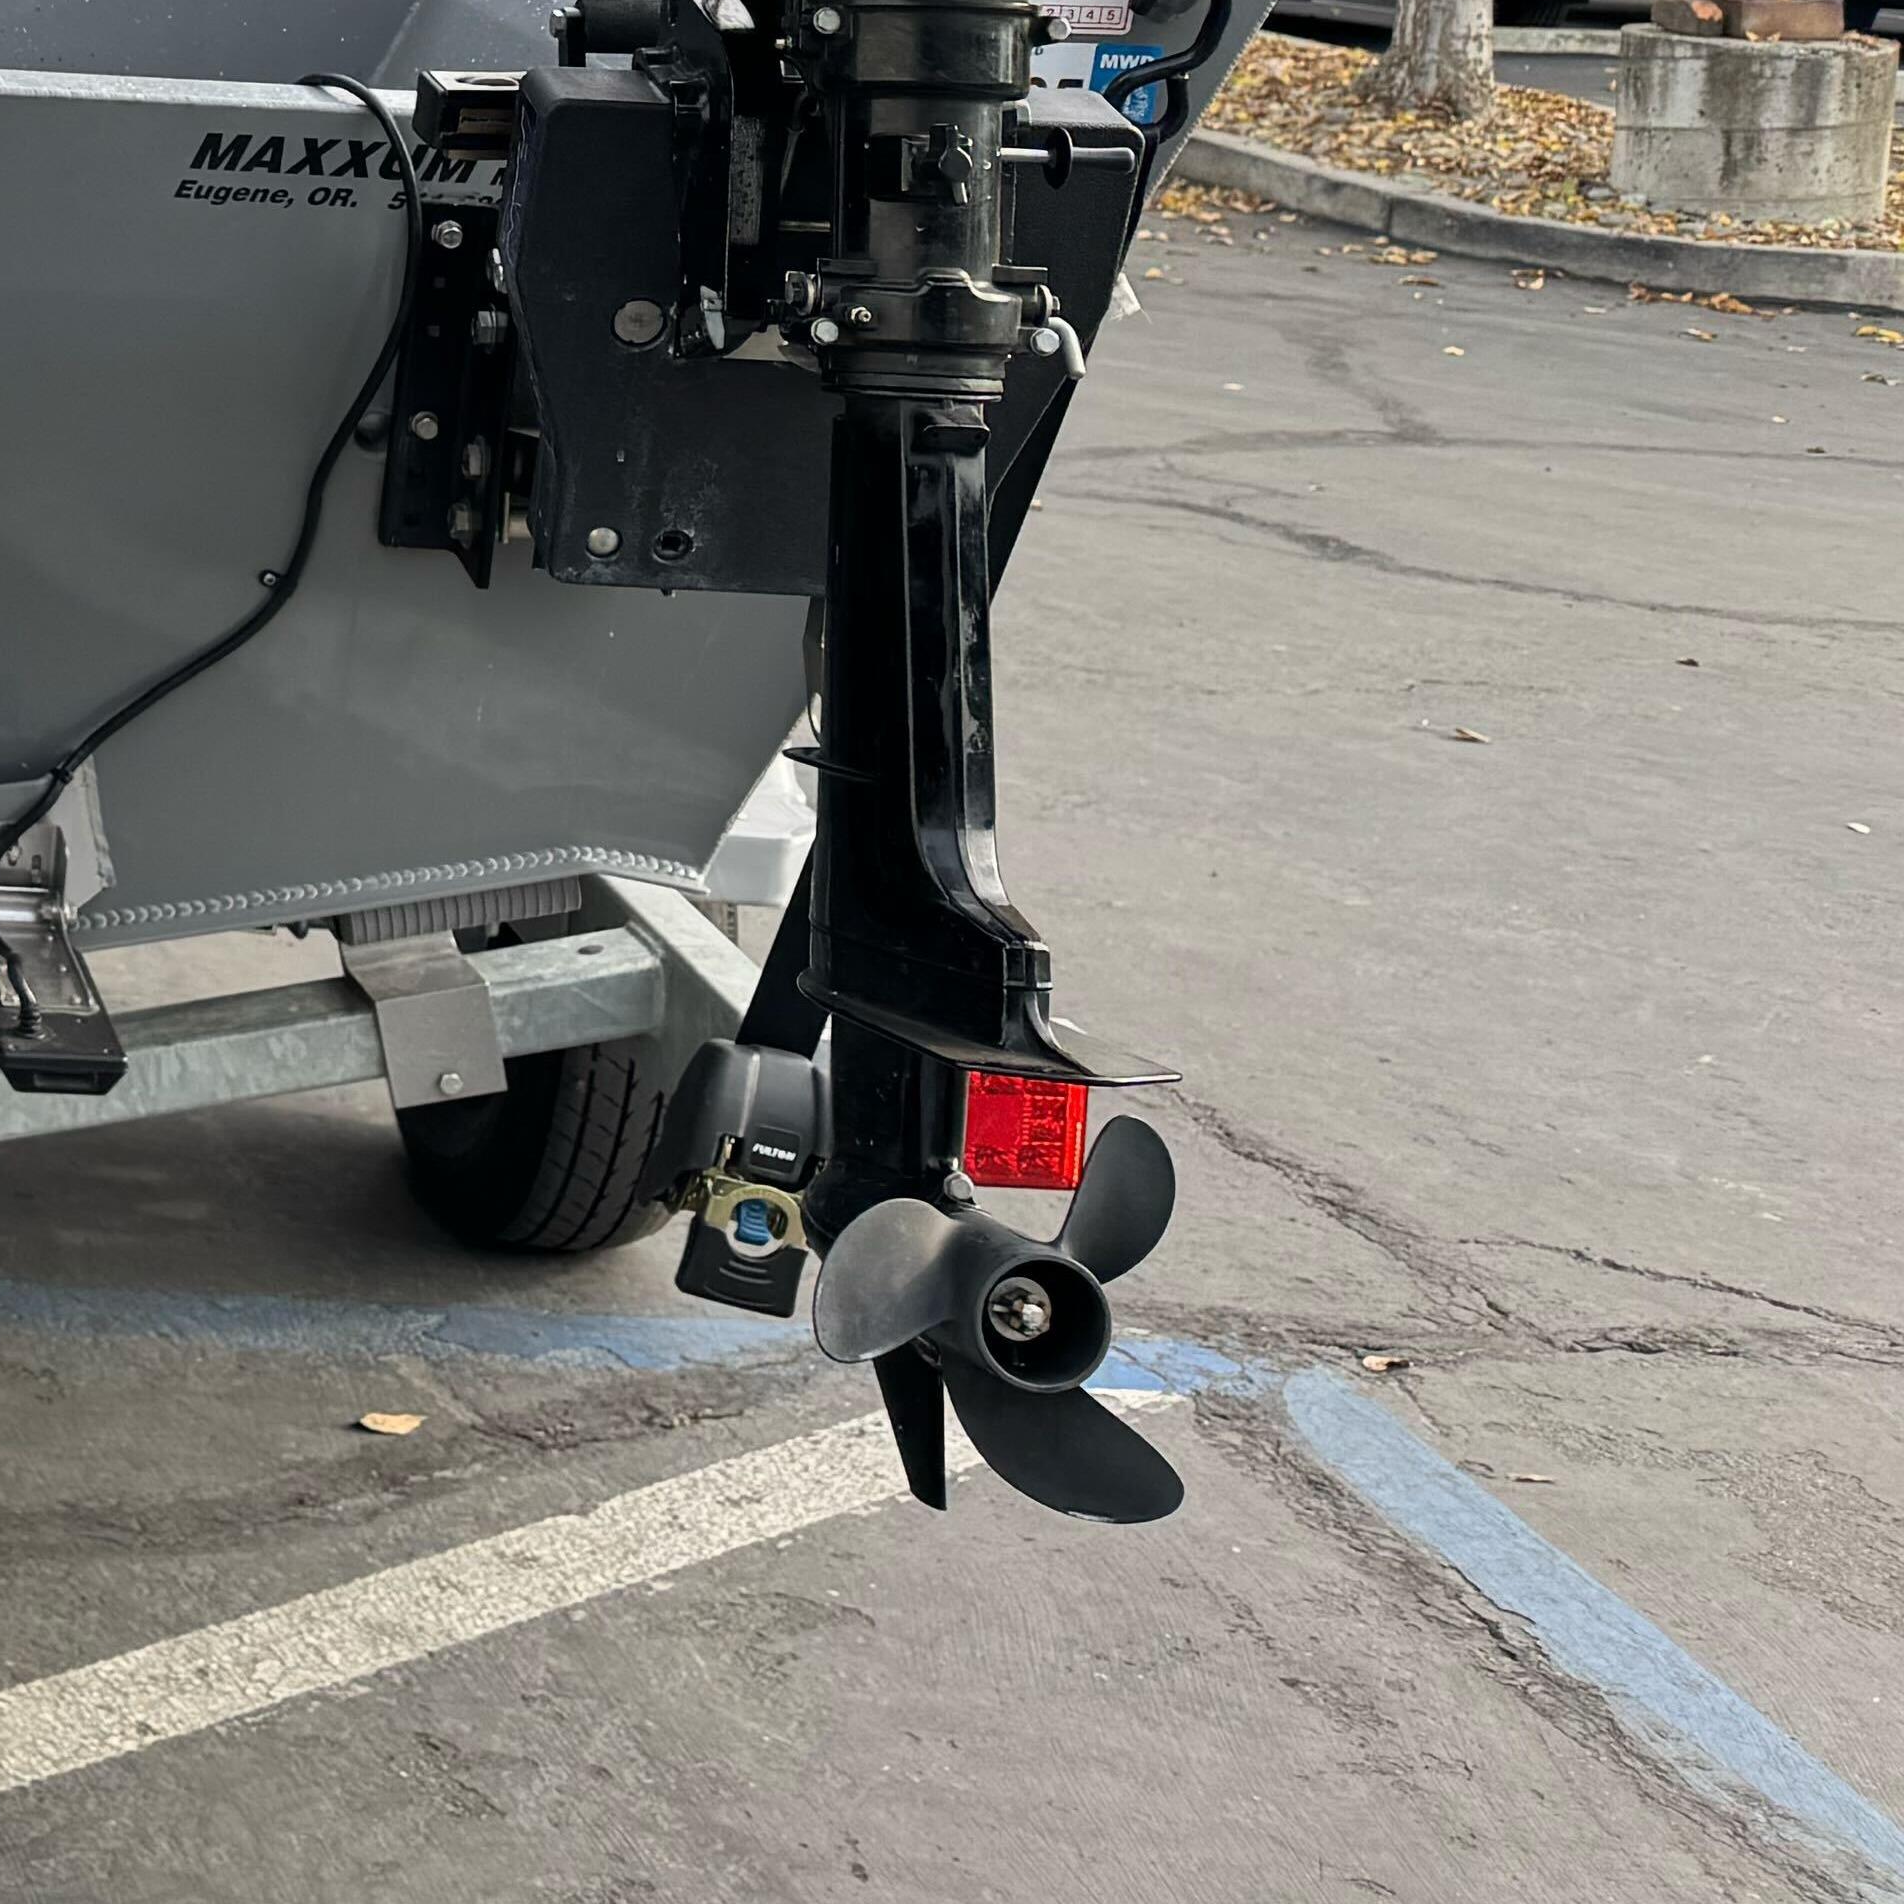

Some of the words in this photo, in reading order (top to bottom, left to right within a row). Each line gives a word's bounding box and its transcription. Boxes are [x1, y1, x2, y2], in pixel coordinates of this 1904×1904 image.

[1086, 9, 1096, 21] 4
[1106, 9, 1116, 22] 5
[189, 133, 478, 183] MAXXUM
[173, 179, 295, 208] Eugene,
[307, 188, 359, 208] OR.
